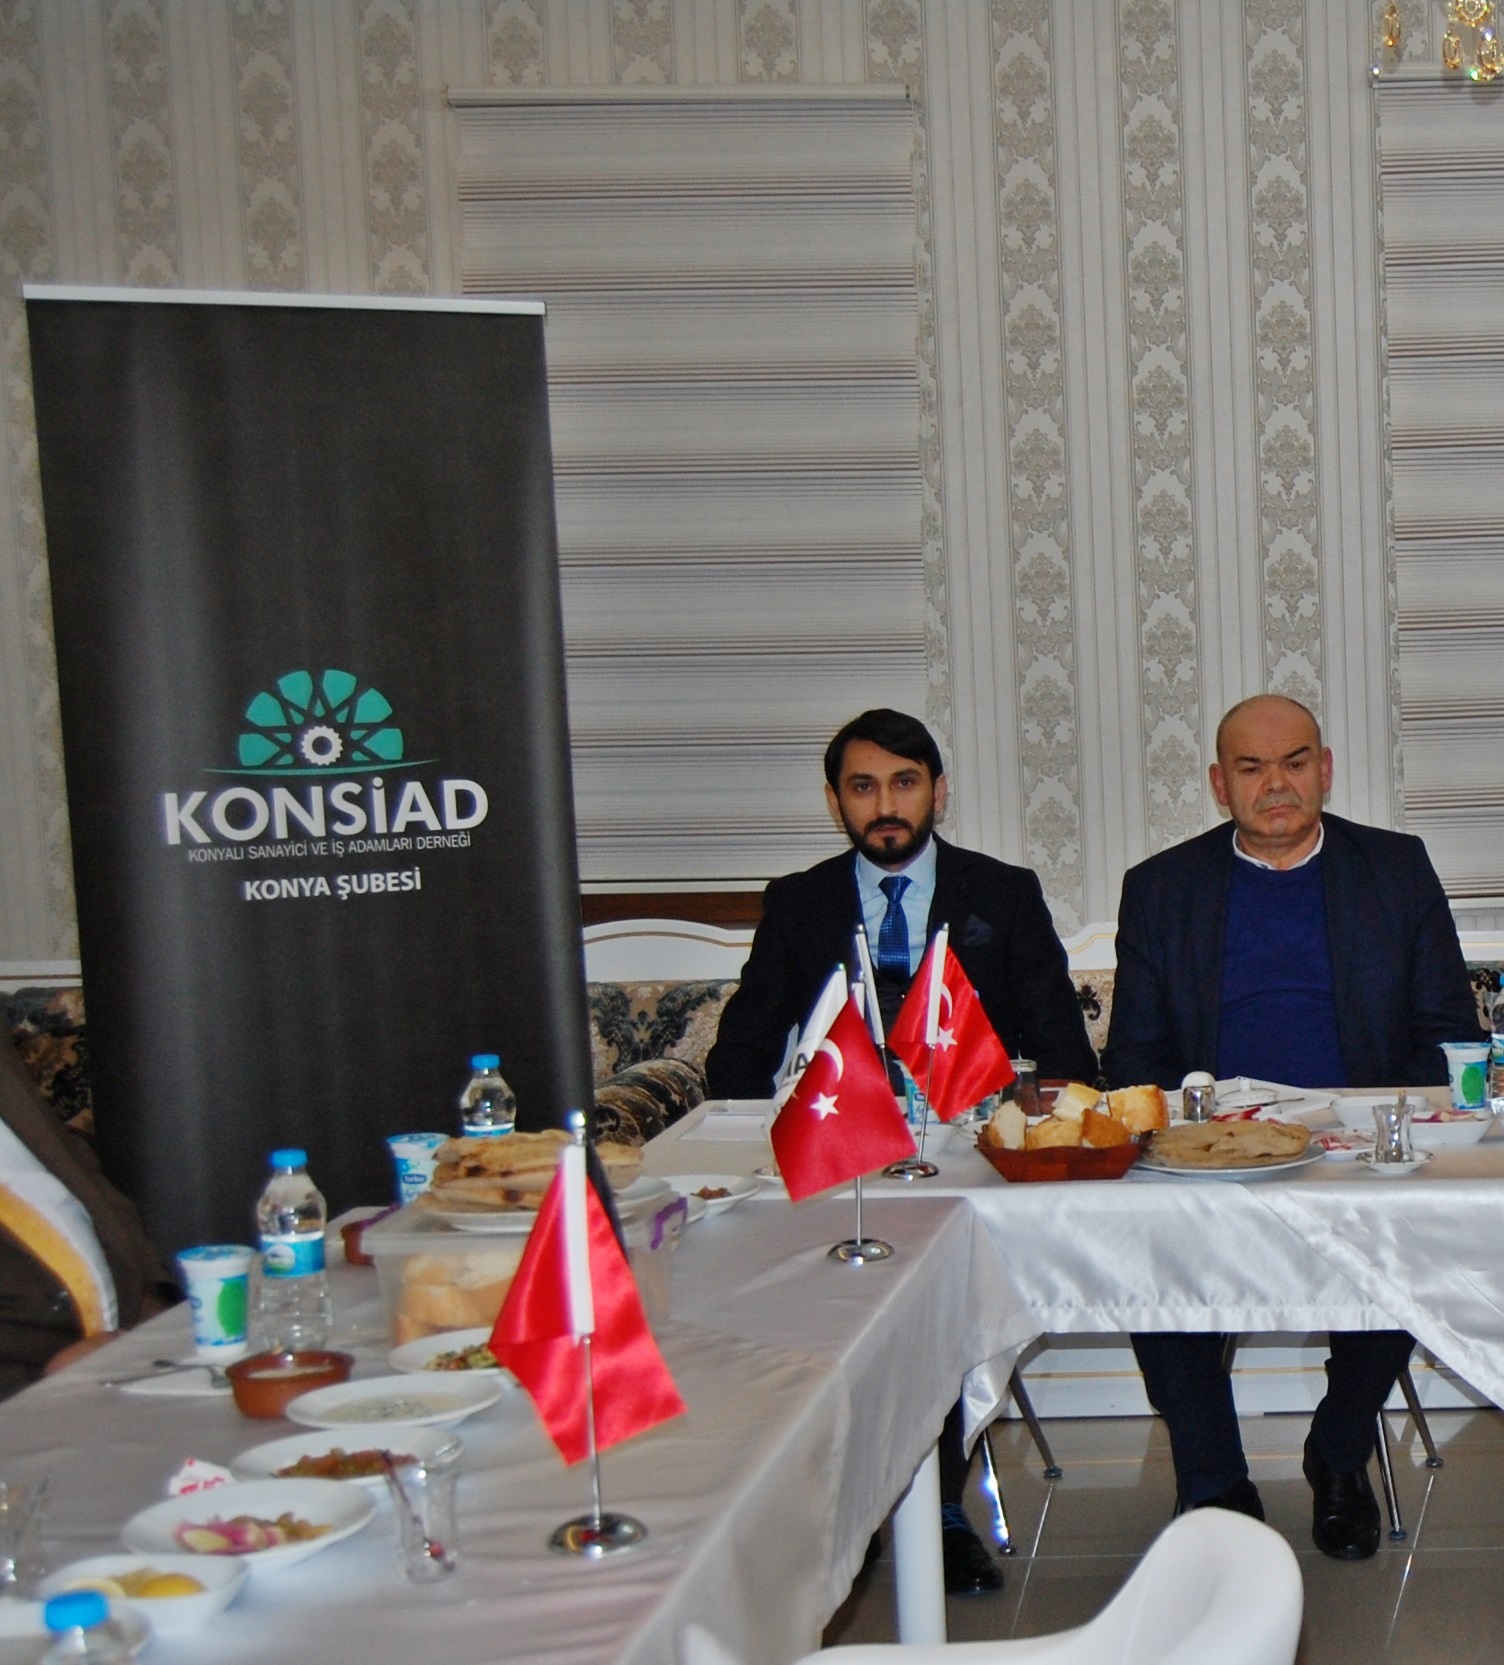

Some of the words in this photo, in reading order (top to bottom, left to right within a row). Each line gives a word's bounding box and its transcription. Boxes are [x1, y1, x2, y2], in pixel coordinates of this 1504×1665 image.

[163, 776, 490, 845] KONSİAD
[188, 846, 244, 862] KONYALI
[248, 840, 307, 859] SANAYİCİ
[311, 842, 329, 855] VE
[331, 838, 345, 857] İŞ
[348, 838, 413, 854] ADAMLARI
[416, 831, 471, 850] DERNEĞİ
[245, 876, 331, 901] KONYA
[337, 866, 422, 901] ŞUBESİ
